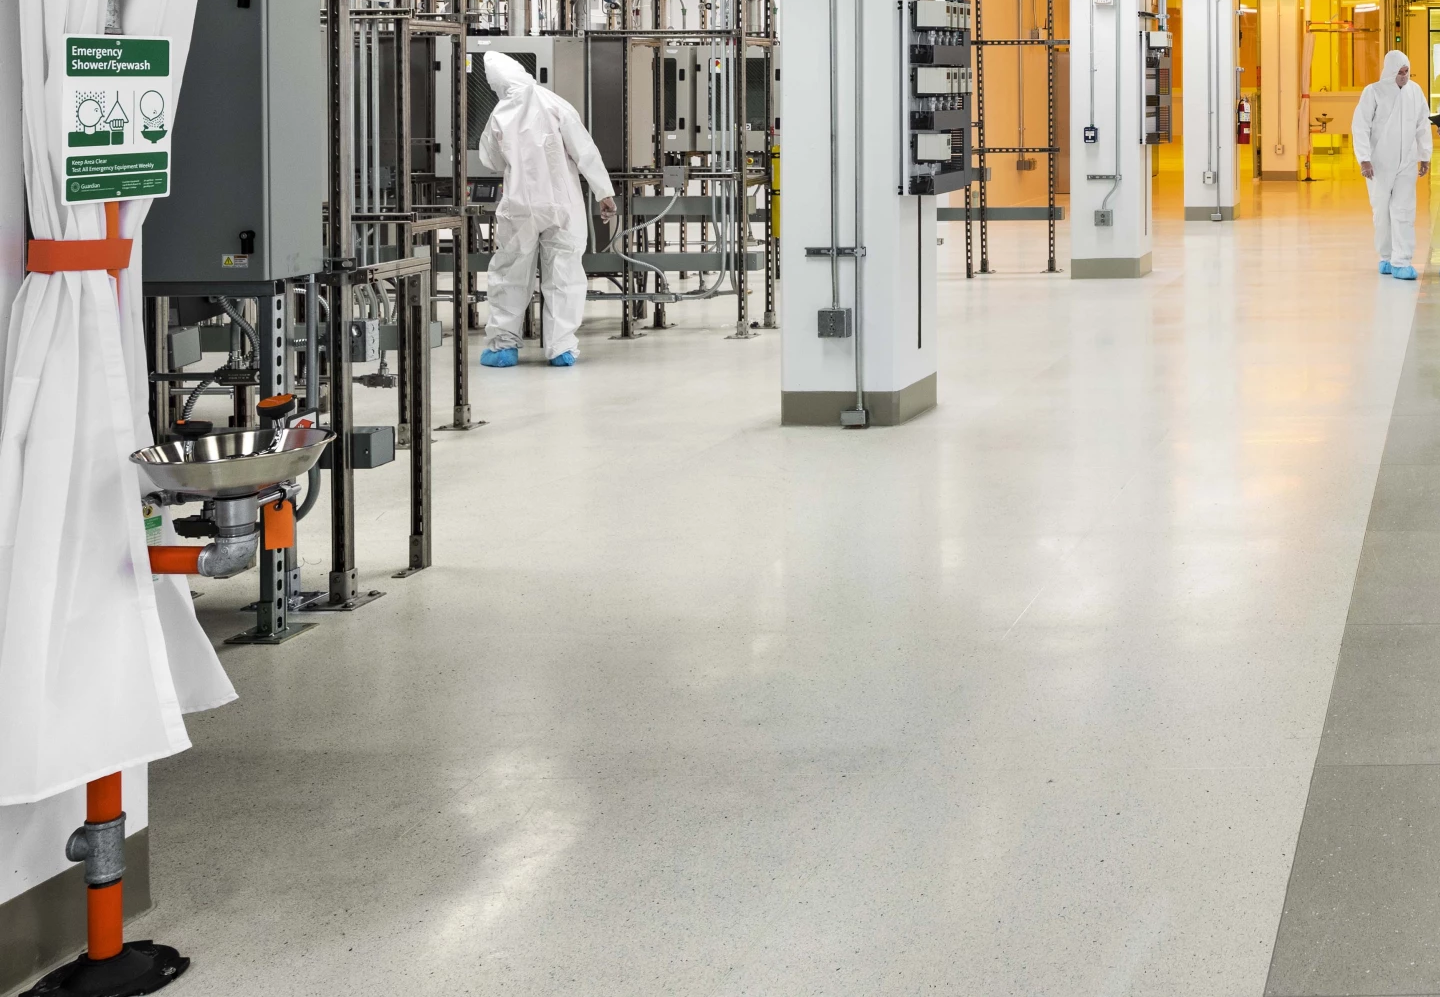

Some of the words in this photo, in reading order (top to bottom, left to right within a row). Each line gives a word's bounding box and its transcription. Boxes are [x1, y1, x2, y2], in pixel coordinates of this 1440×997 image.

[71, 45, 122, 59] Emergency
[71, 59, 150, 73] Shower/Eyewash
[89, 165, 114, 173] Emergency
[114, 163, 138, 171] Equipment
